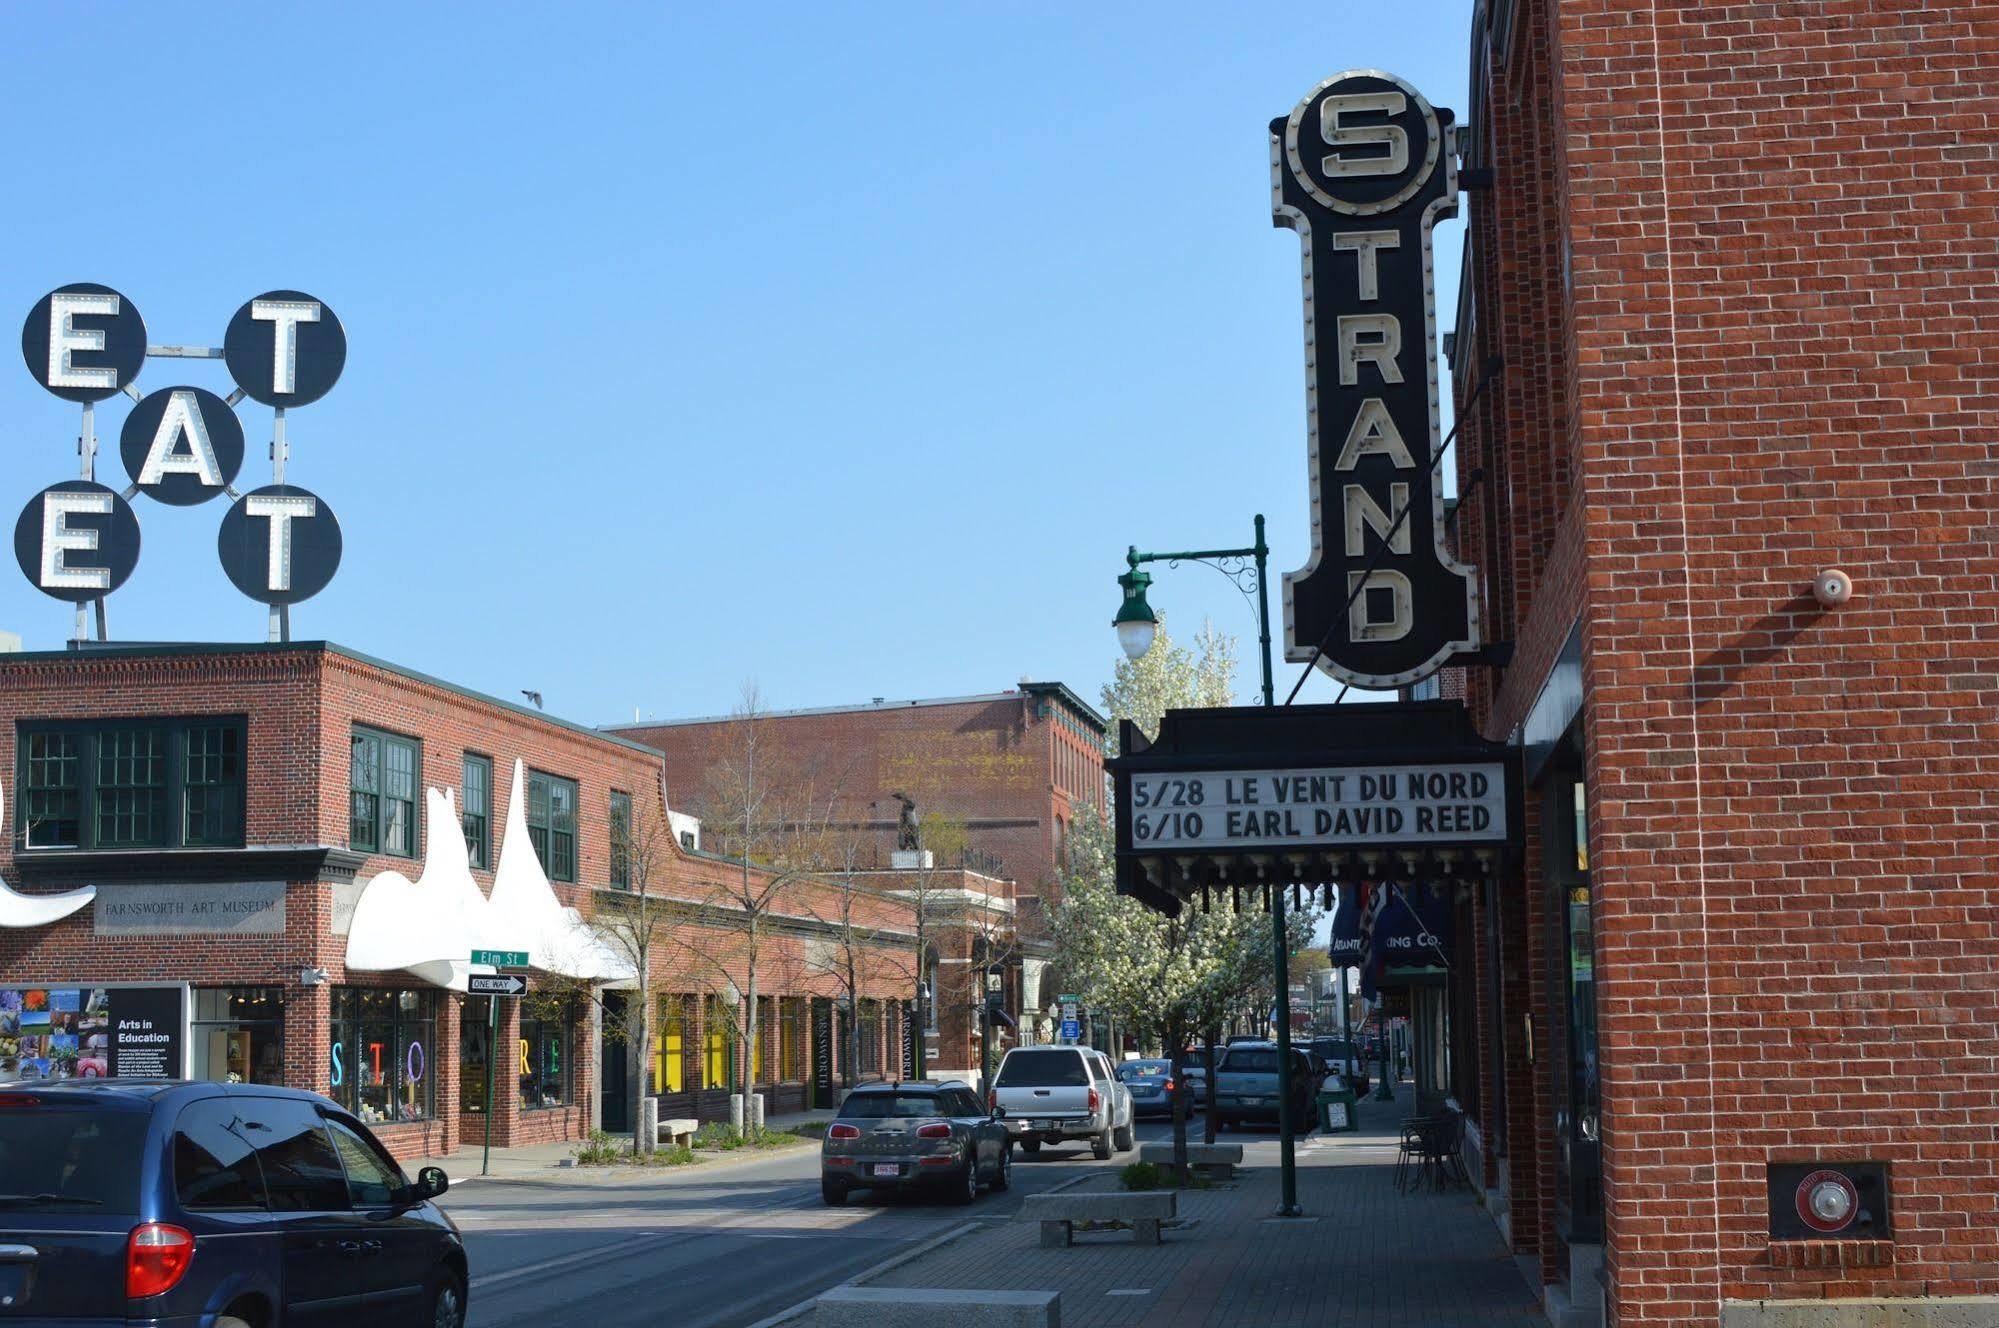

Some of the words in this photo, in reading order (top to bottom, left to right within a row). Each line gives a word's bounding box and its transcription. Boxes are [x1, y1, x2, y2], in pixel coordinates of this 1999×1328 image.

[1320, 91, 1416, 642] STRAND
[1134, 779, 1204, 808] 5/28
[1225, 778, 1258, 805] LE
[1272, 775, 1346, 803] VENT
[1359, 774, 1397, 801] DU
[1408, 771, 1489, 800] NORD
[1134, 812, 1203, 840] 6/10
[1226, 810, 1301, 837] EARL
[1314, 807, 1403, 836] DAVID
[1416, 804, 1491, 833] REED
[105, 902, 184, 916] FARNSWORTH
[191, 901, 214, 914] ART
[222, 900, 275, 914] MUSEUM
[481, 952, 501, 965] Elm
[506, 953, 518, 965] St
[473, 979, 490, 989] ONE
[492, 979, 509, 989] WAY
[118, 1019, 141, 1030] Arts
[142, 1019, 153, 1030] in
[118, 1032, 170, 1043] Education
